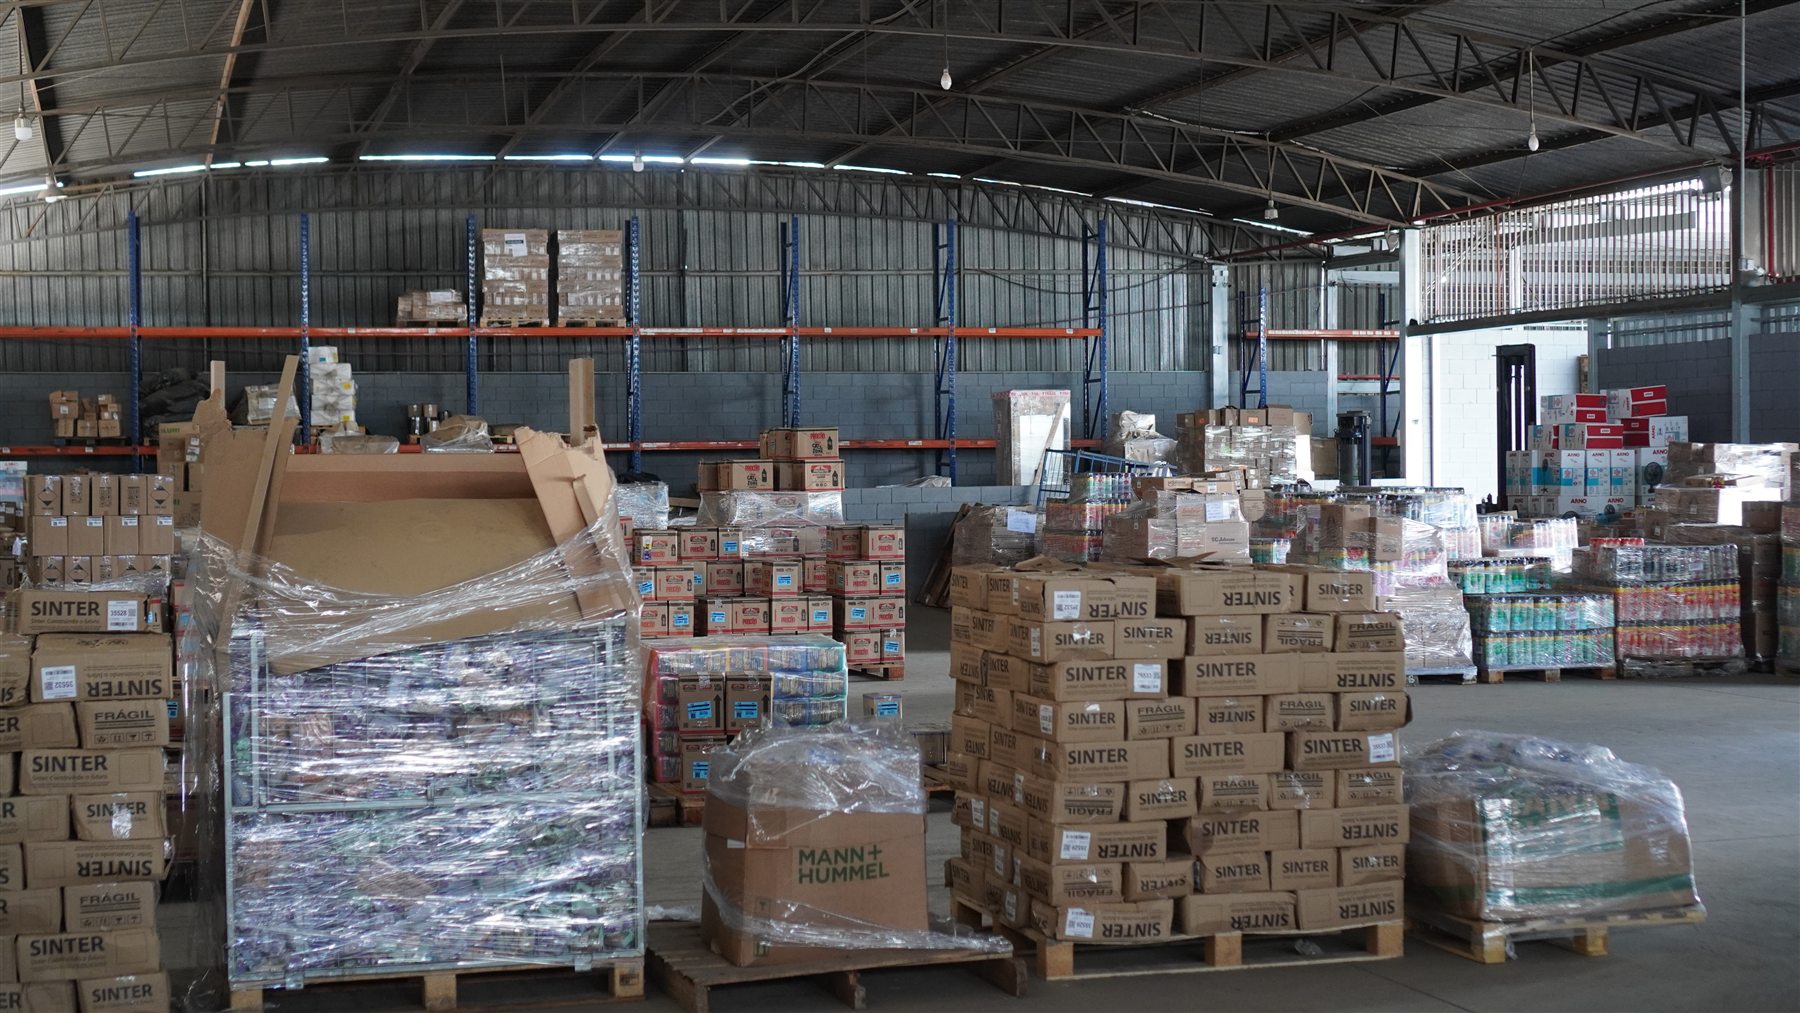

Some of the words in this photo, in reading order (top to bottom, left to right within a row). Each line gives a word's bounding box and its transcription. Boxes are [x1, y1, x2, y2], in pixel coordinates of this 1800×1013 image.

[951, 574, 968, 589] SINTER
[989, 577, 1010, 592] SINTER
[1318, 584, 1363, 595] SINTER
[1223, 591, 1281, 606] SINTER
[31, 601, 100, 616] SINTER
[1089, 601, 1148, 618] SINTER
[1055, 633, 1105, 646] SINTER
[1123, 626, 1173, 639] SINTER
[1205, 632, 1252, 644] SINTER
[1065, 666, 1127, 681] SINTER
[1196, 662, 1256, 678] SINTER
[87, 679, 162, 697] SINTER
[1337, 673, 1396, 688] SINTER
[1016, 700, 1038, 717] SINTER
[1350, 699, 1396, 712] SINTER
[95, 709, 155, 721] FRÁGIL
[1068, 712, 1116, 726] SINTER
[1209, 710, 1256, 724] SINTER
[964, 738, 985, 756] SINTER
[993, 731, 1017, 749] SINTER
[1304, 738, 1363, 754] SINTER
[1068, 748, 1128, 765] SINTER
[1184, 741, 1245, 758] SINTER
[32, 755, 108, 772] SINTER
[988, 777, 1015, 798] SINTER
[1139, 790, 1188, 806] SINTER
[87, 801, 146, 818] SINTER
[1202, 819, 1260, 837] SINTER
[1342, 823, 1399, 840] SINTER
[1098, 843, 1157, 859] SINTER
[77, 861, 153, 877] SINTER
[1282, 861, 1329, 874] SINTER
[1352, 855, 1398, 869] SINTER
[799, 863, 890, 884] HUMMEL
[1215, 863, 1261, 879] SINTER
[1339, 900, 1396, 919] SINTER
[1102, 922, 1161, 938] SINTER
[1231, 914, 1290, 930] SINTER
[30, 935, 104, 956] SINTER
[92, 984, 153, 1003] SINTER
